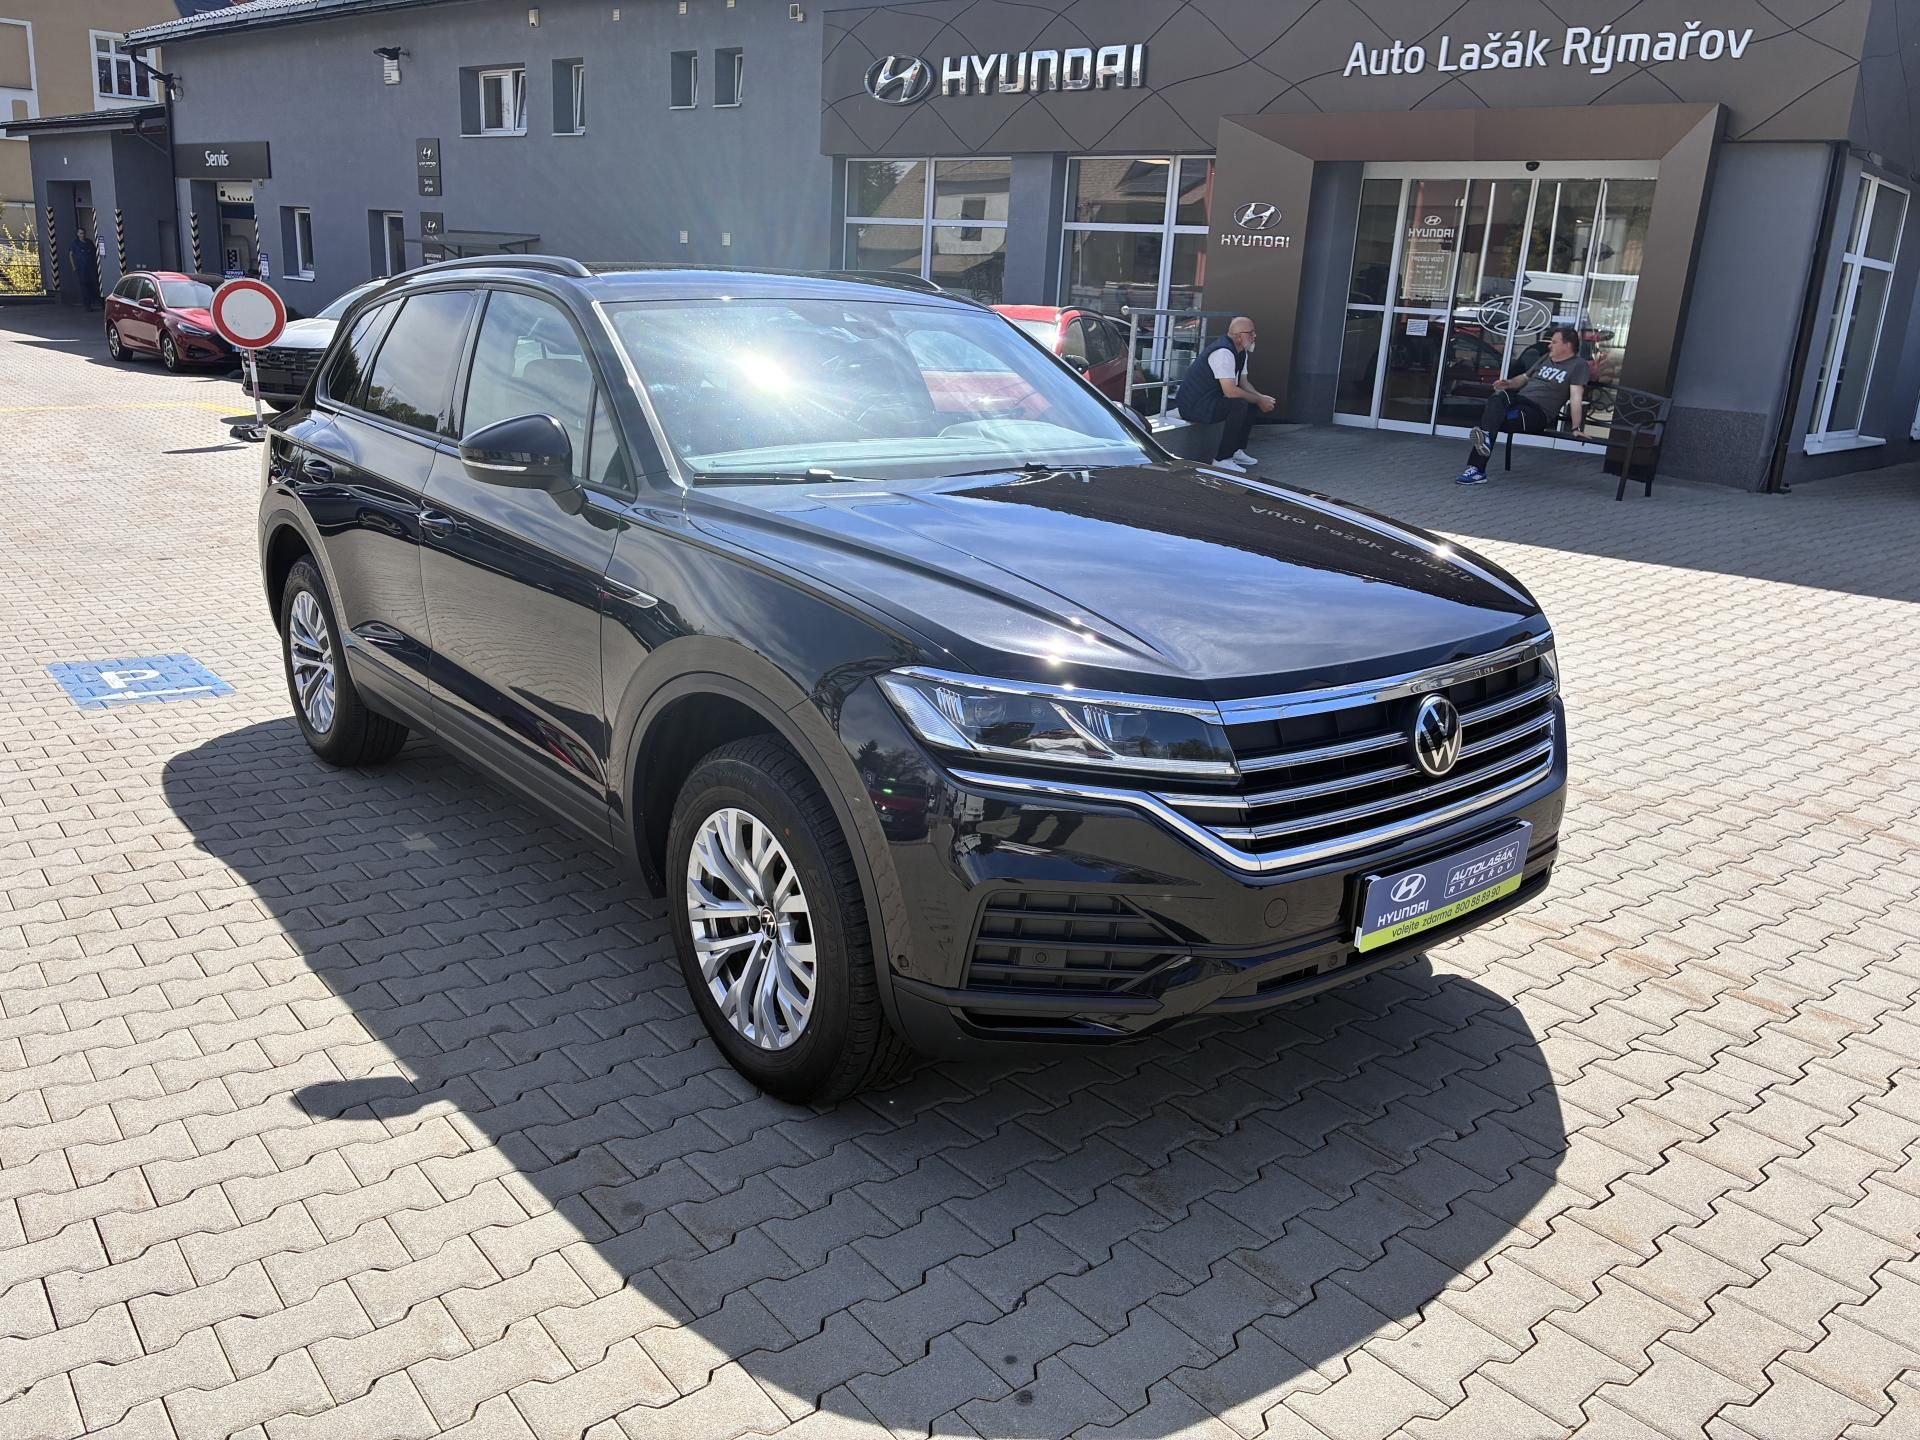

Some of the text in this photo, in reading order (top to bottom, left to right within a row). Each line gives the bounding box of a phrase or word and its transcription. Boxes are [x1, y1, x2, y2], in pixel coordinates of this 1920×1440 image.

[1343, 21, 1753, 77] Auto Lašák Rýmařov
[942, 44, 1143, 95] HYUNDAI
[205, 150, 229, 167] Servis
[1221, 234, 1290, 248] HYUNDAI
[1408, 228, 1455, 238] HYUNDAI
[1451, 847, 1515, 882] AUTOLAŠÁK
[1377, 900, 1429, 927] HYUNDAI
[1392, 922, 1420, 938] volejte
[1422, 909, 1452, 927] zdarma
[1455, 901, 1470, 914] 800
[1470, 896, 1481, 907] 88
[1491, 886, 1501, 898] 90
